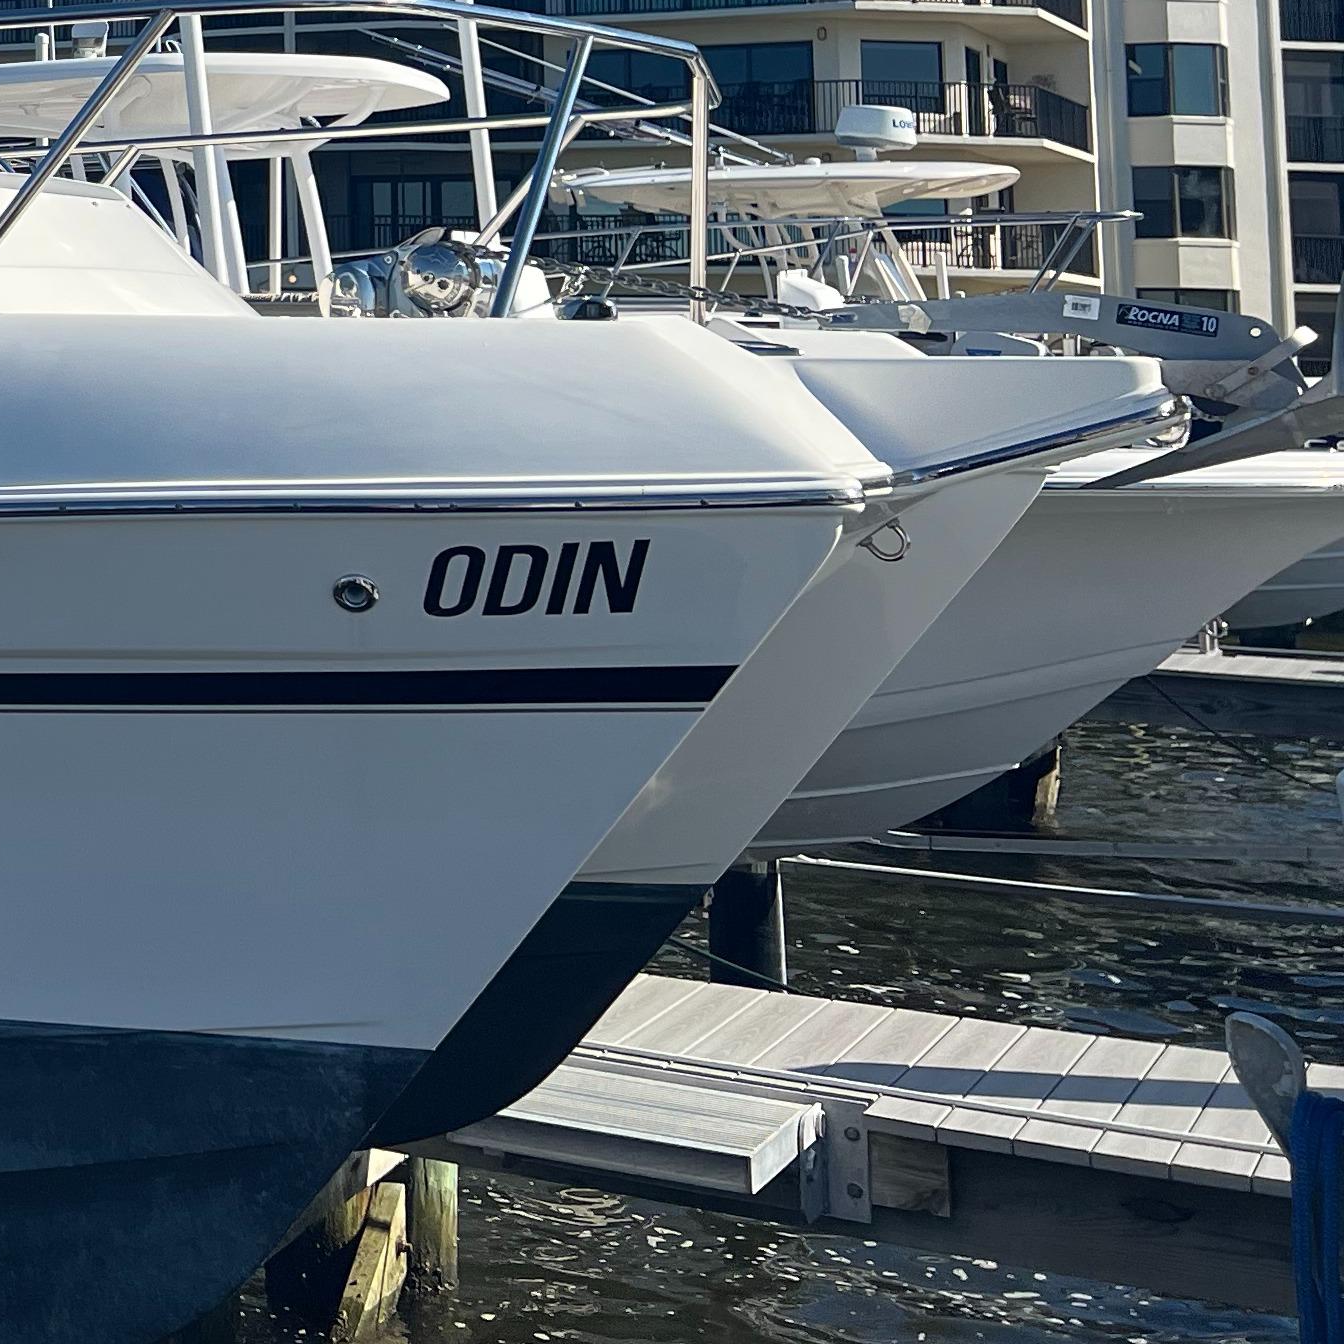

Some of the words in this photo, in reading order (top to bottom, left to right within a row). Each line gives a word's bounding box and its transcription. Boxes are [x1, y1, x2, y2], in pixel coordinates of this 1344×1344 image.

[1127, 306, 1180, 327] ROCNA
[1201, 316, 1217, 333] 10
[422, 538, 651, 618] ODIN
